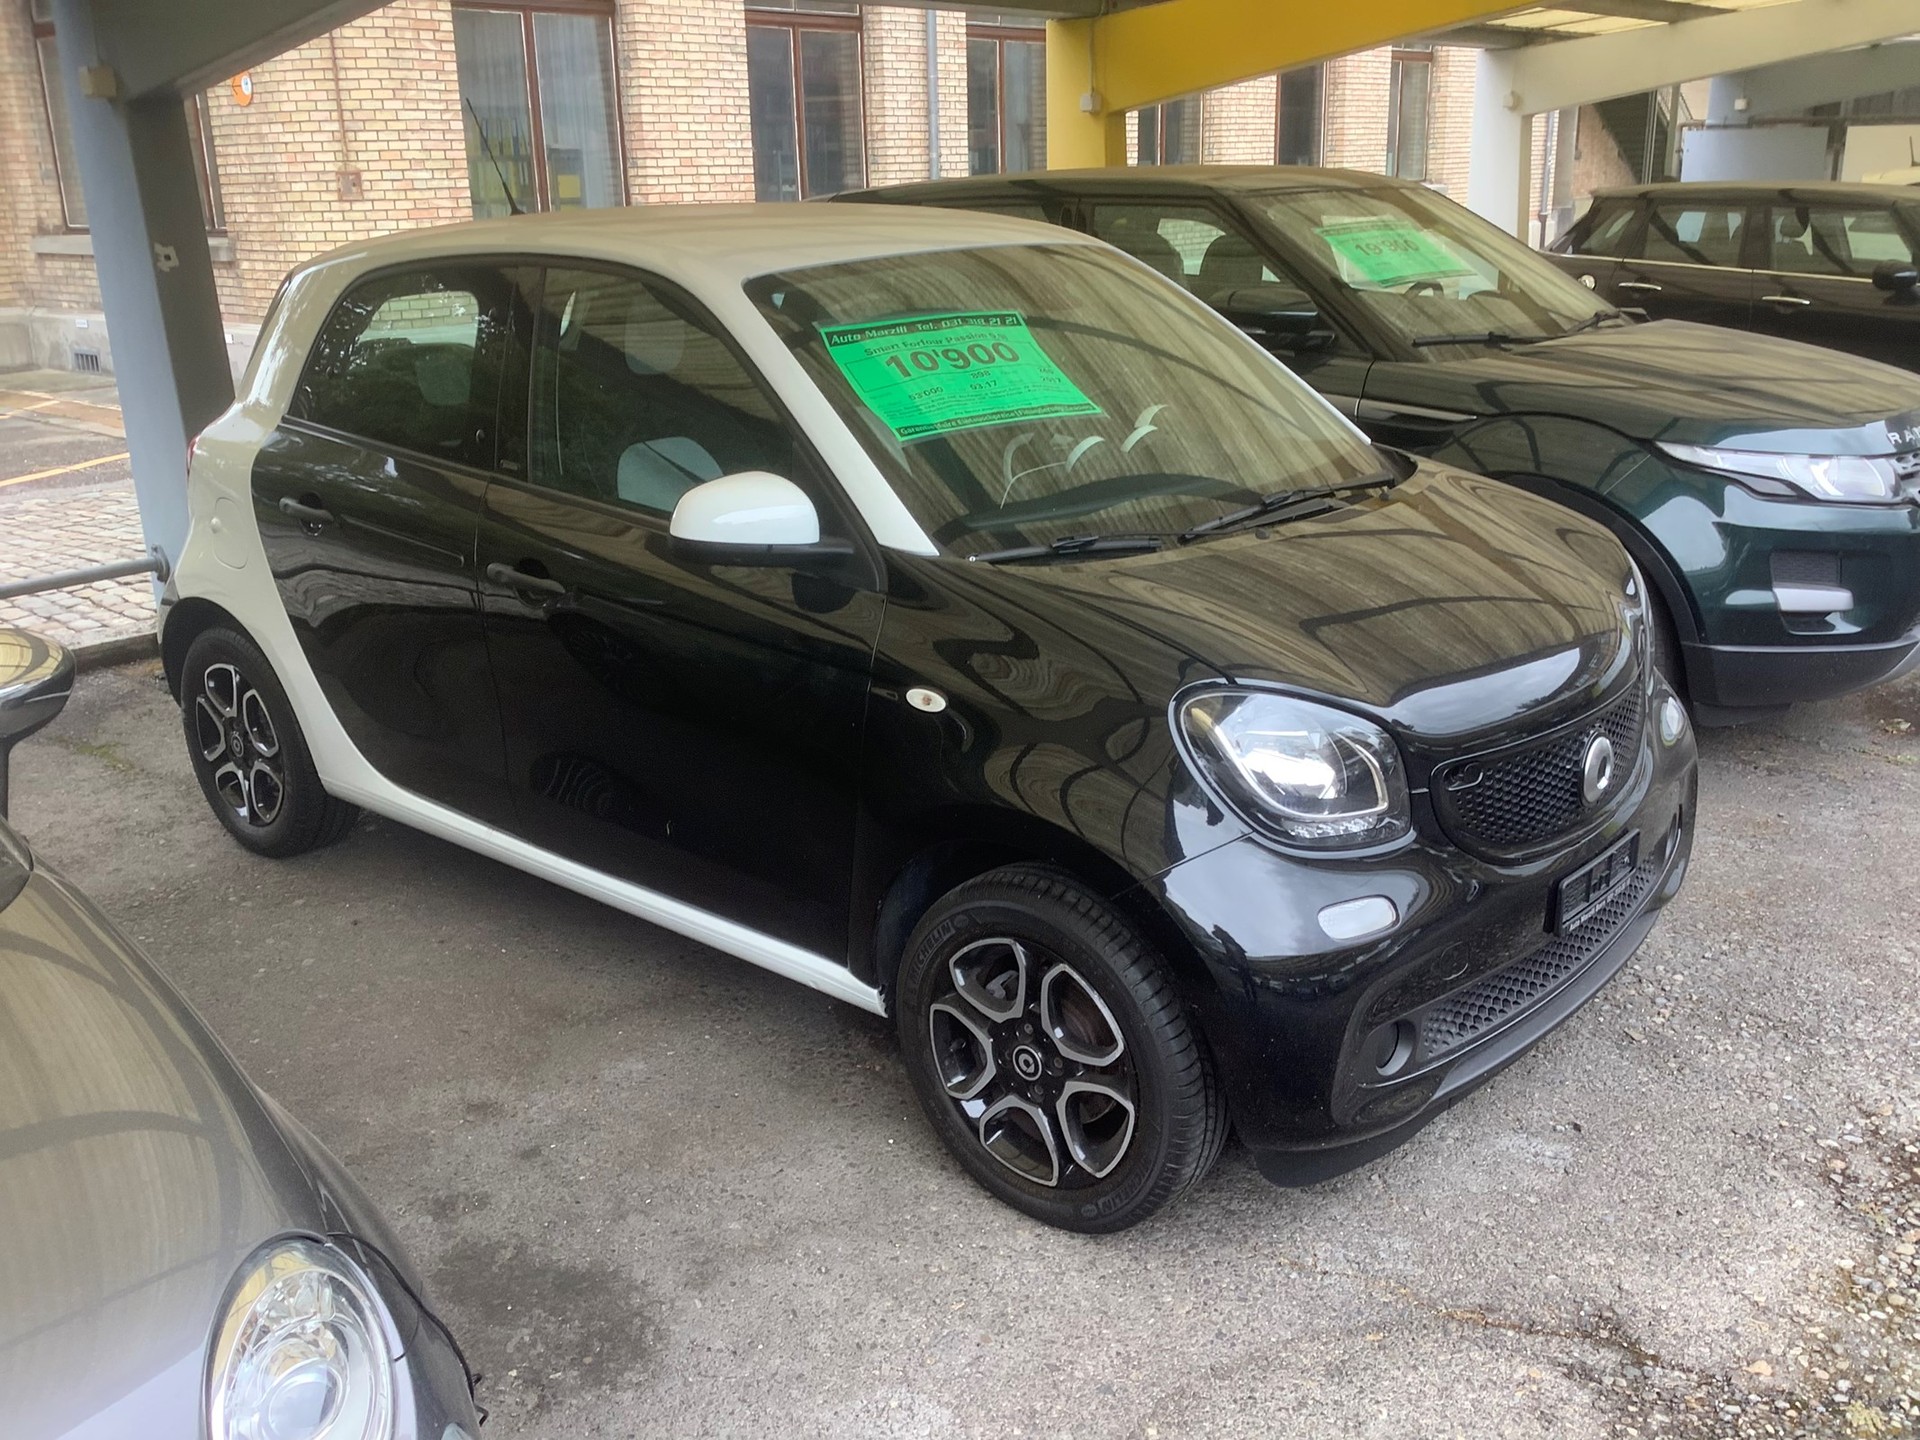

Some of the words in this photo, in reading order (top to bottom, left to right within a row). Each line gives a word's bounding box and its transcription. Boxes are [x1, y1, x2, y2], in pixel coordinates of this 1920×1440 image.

[831, 334, 861, 345] Auto
[915, 322, 937, 331] Tel.
[941, 318, 962, 328] 031
[989, 317, 1001, 326] 21
[1005, 316, 1017, 325] 21
[864, 343, 900, 356] Smart
[901, 338, 943, 349] Forfour
[945, 332, 988, 344] Passion
[885, 342, 1020, 378] 10'900
[909, 921, 953, 985] MICHELIN
